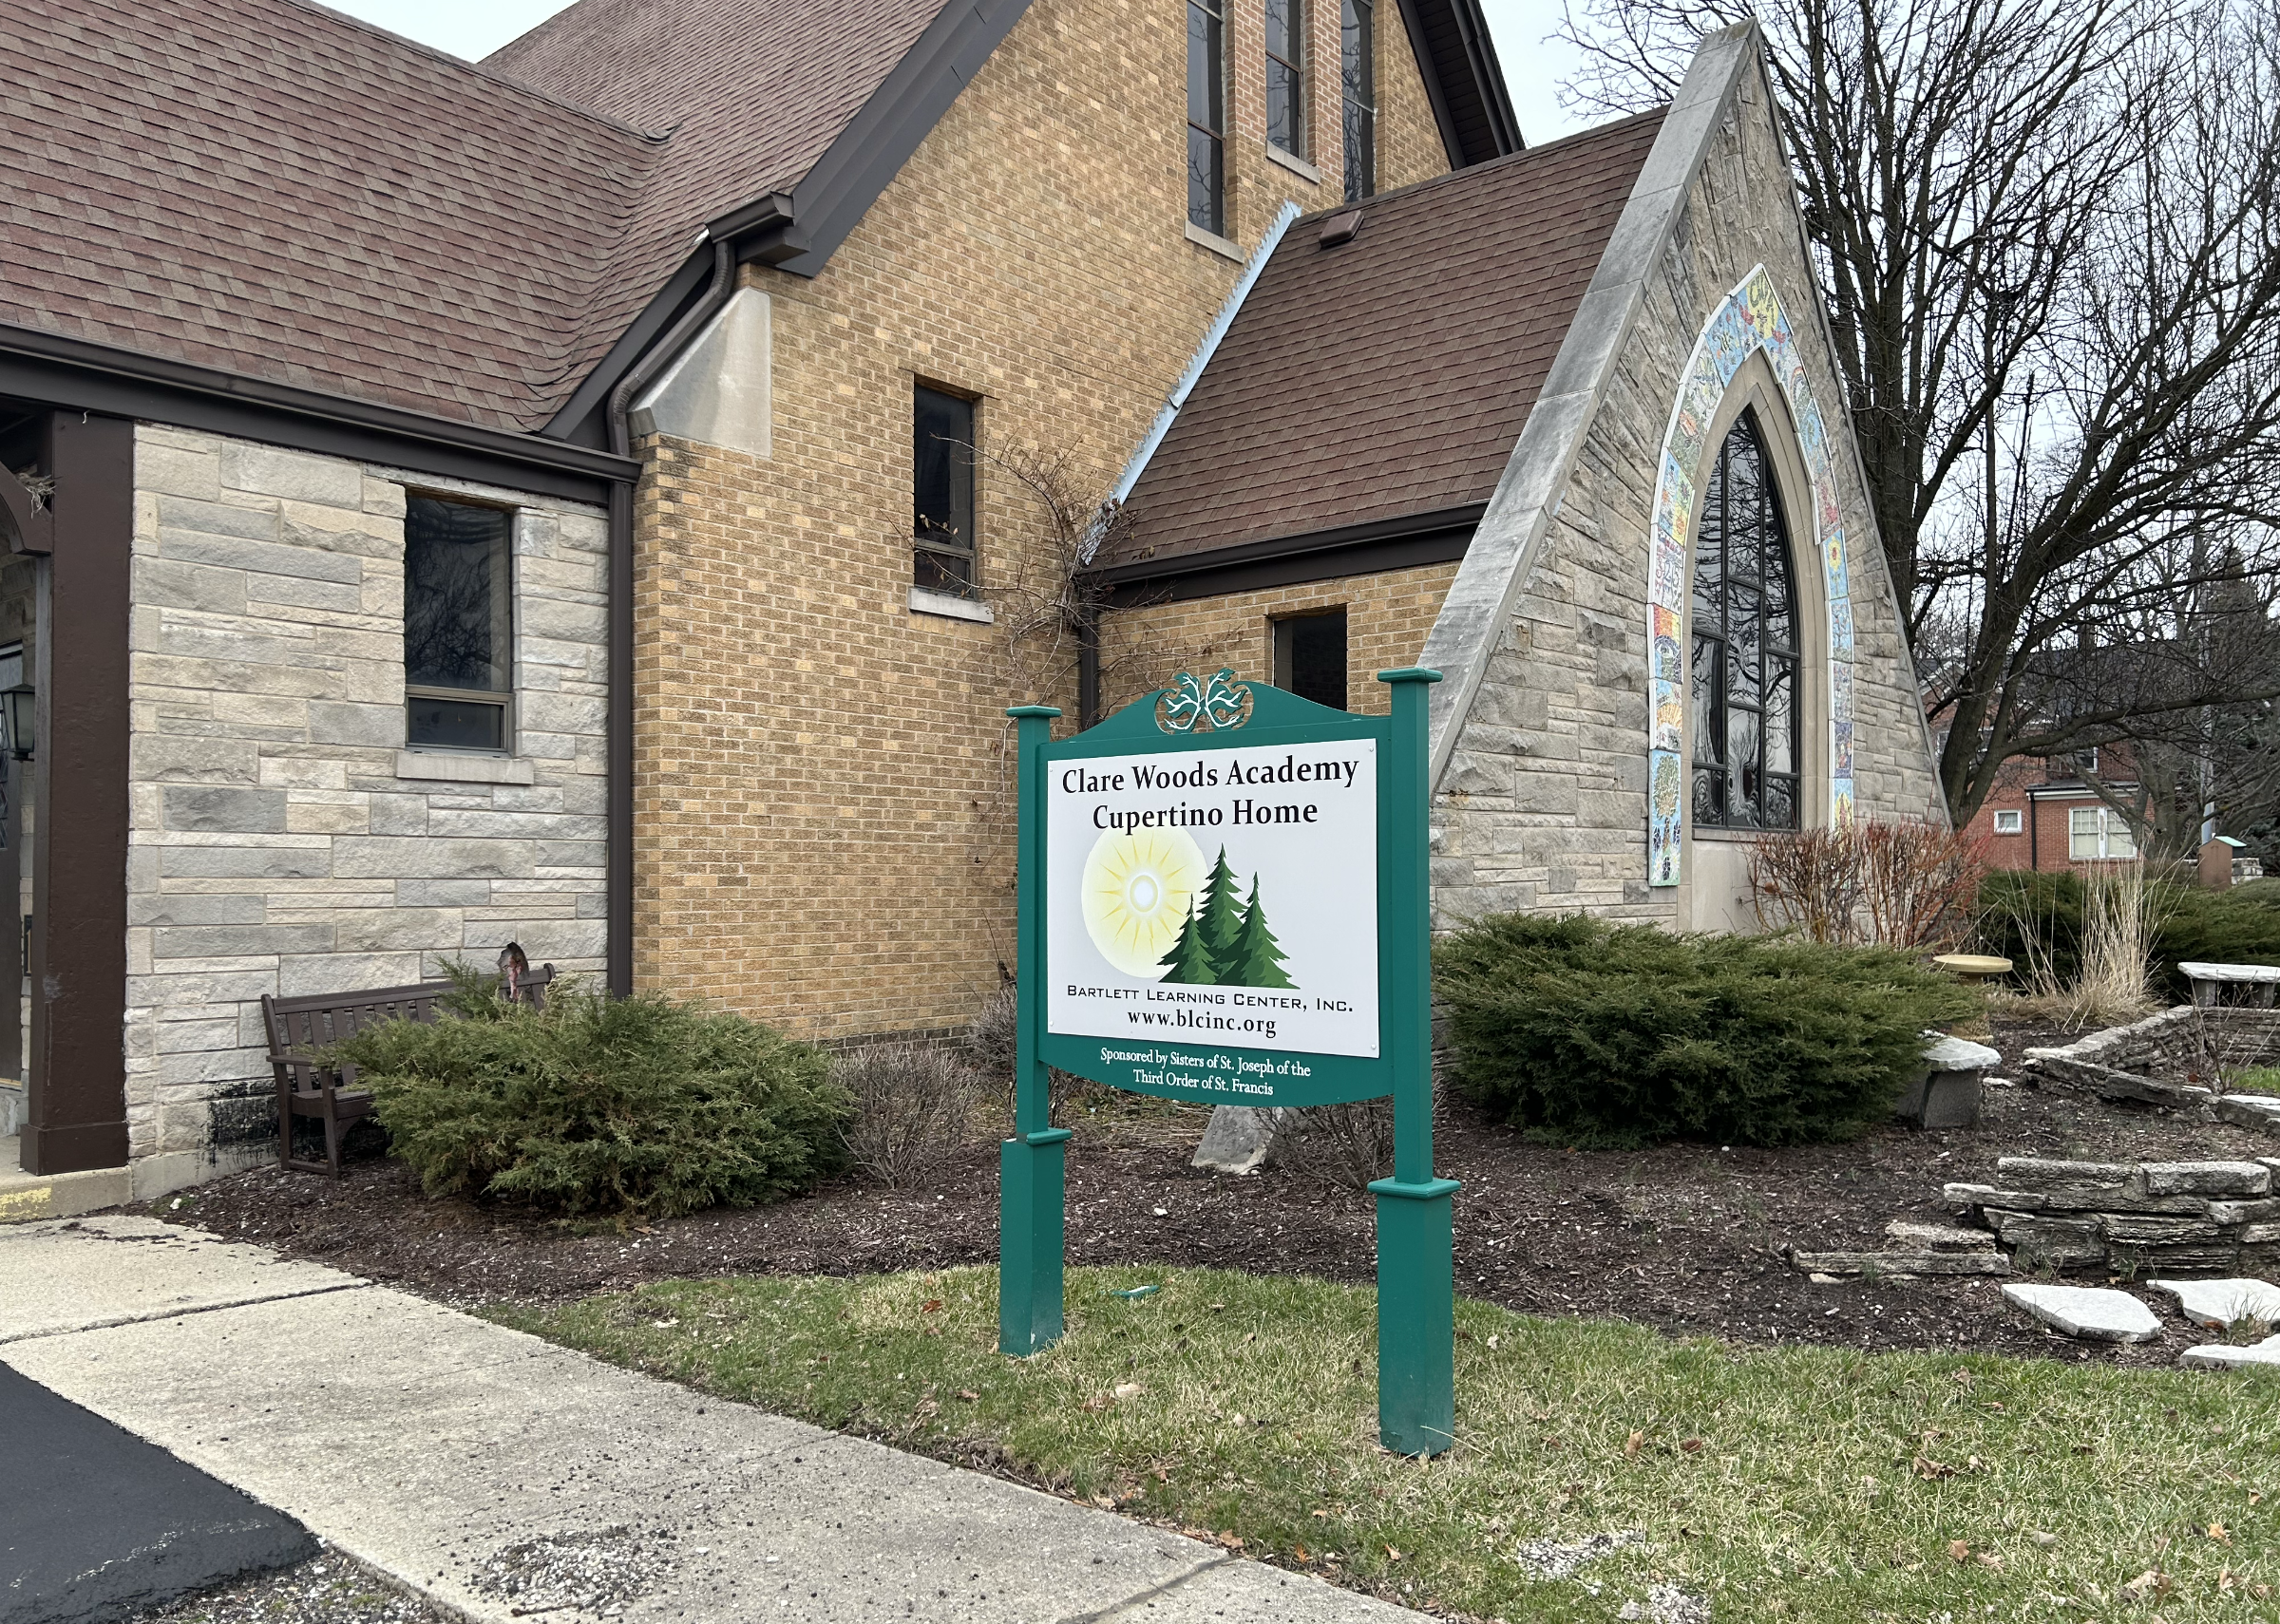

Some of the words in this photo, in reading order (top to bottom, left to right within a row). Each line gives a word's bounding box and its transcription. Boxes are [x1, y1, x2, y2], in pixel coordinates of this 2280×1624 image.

[1063, 768, 1125, 794] Clare
[1131, 761, 1218, 789] Woods
[1226, 755, 1359, 787] Academy
[1093, 802, 1223, 836] Cupertino
[1232, 800, 1317, 824] Home
[1127, 1009, 1277, 1038] www.blcinc.org
[1101, 1048, 1153, 1063] Sponsored
[1155, 1049, 1168, 1068] by
[1170, 1051, 1204, 1067] Sisters
[1206, 1054, 1219, 1068] of
[1221, 1056, 1234, 1069] St.
[1237, 1057, 1274, 1077] Joseph
[1277, 1060, 1290, 1074] of
[1291, 1061, 1311, 1076] the
[1133, 1069, 1164, 1085] Third
[1167, 1072, 1199, 1087] Order
[1202, 1075, 1214, 1089] of
[1215, 1077, 1228, 1091] St.
[1232, 1078, 1273, 1095] Francis
